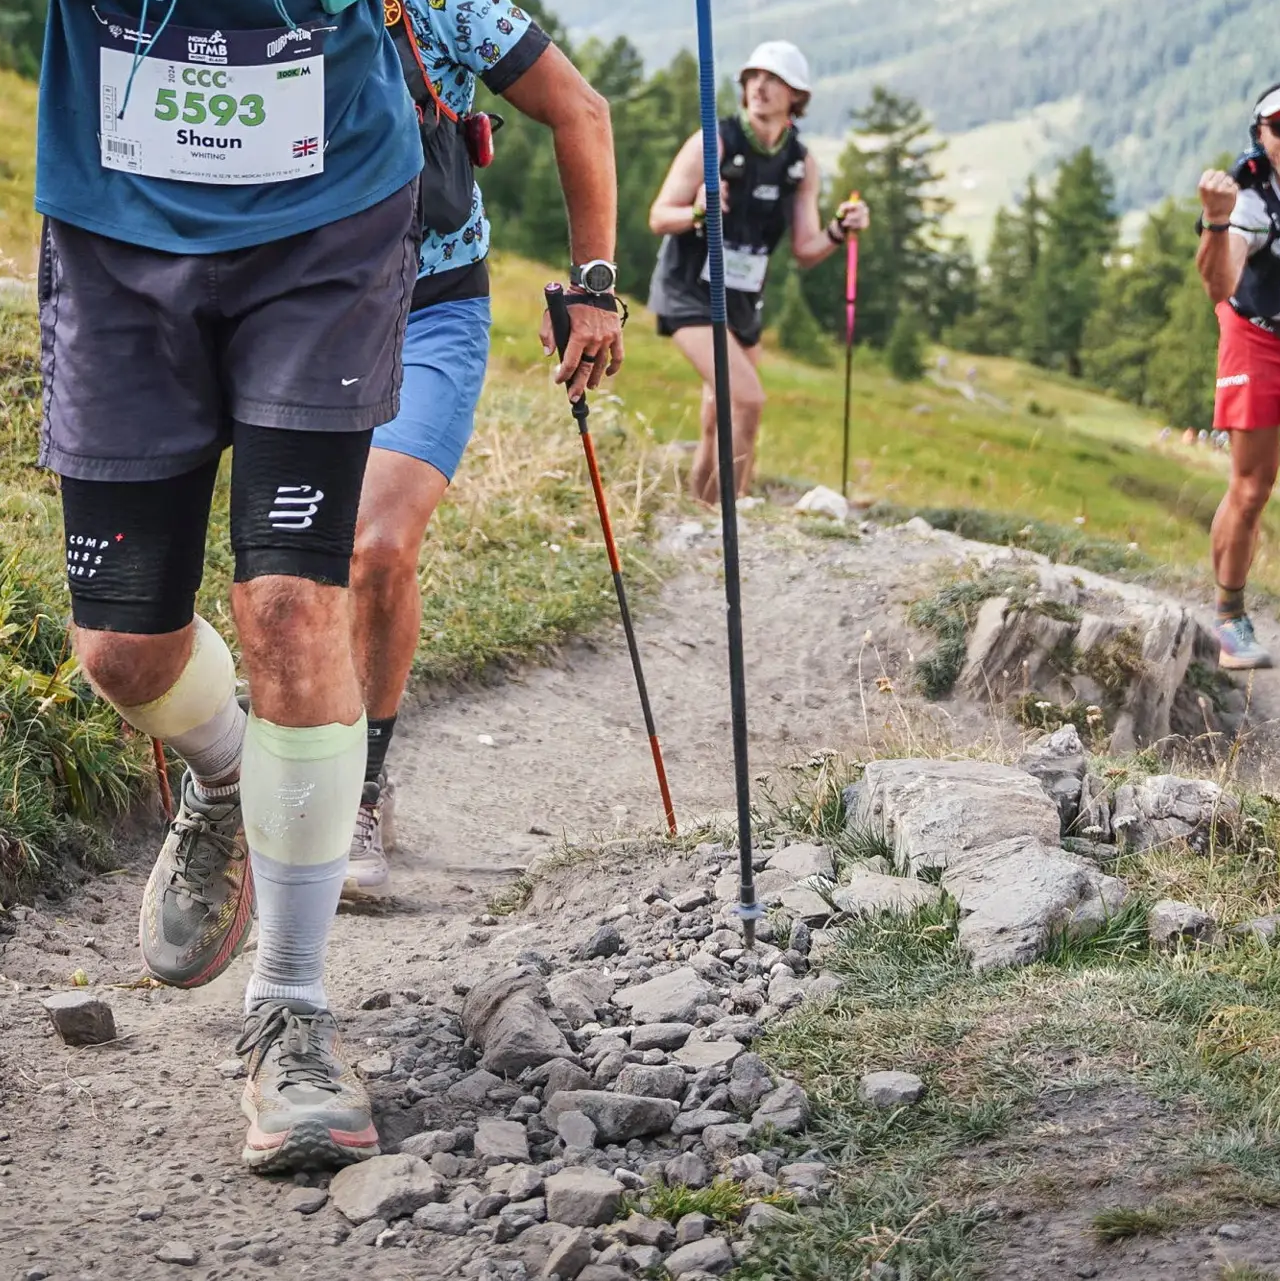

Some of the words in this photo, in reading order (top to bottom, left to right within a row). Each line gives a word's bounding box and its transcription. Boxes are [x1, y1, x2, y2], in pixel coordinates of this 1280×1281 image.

[455, 0, 475, 53] CABRA
[188, 42, 228, 56] UTMB
[154, 87, 266, 127] 5593
[176, 128, 243, 149] Shaun
[190, 150, 226, 161] WHITING
[69, 534, 110, 550] COMP
